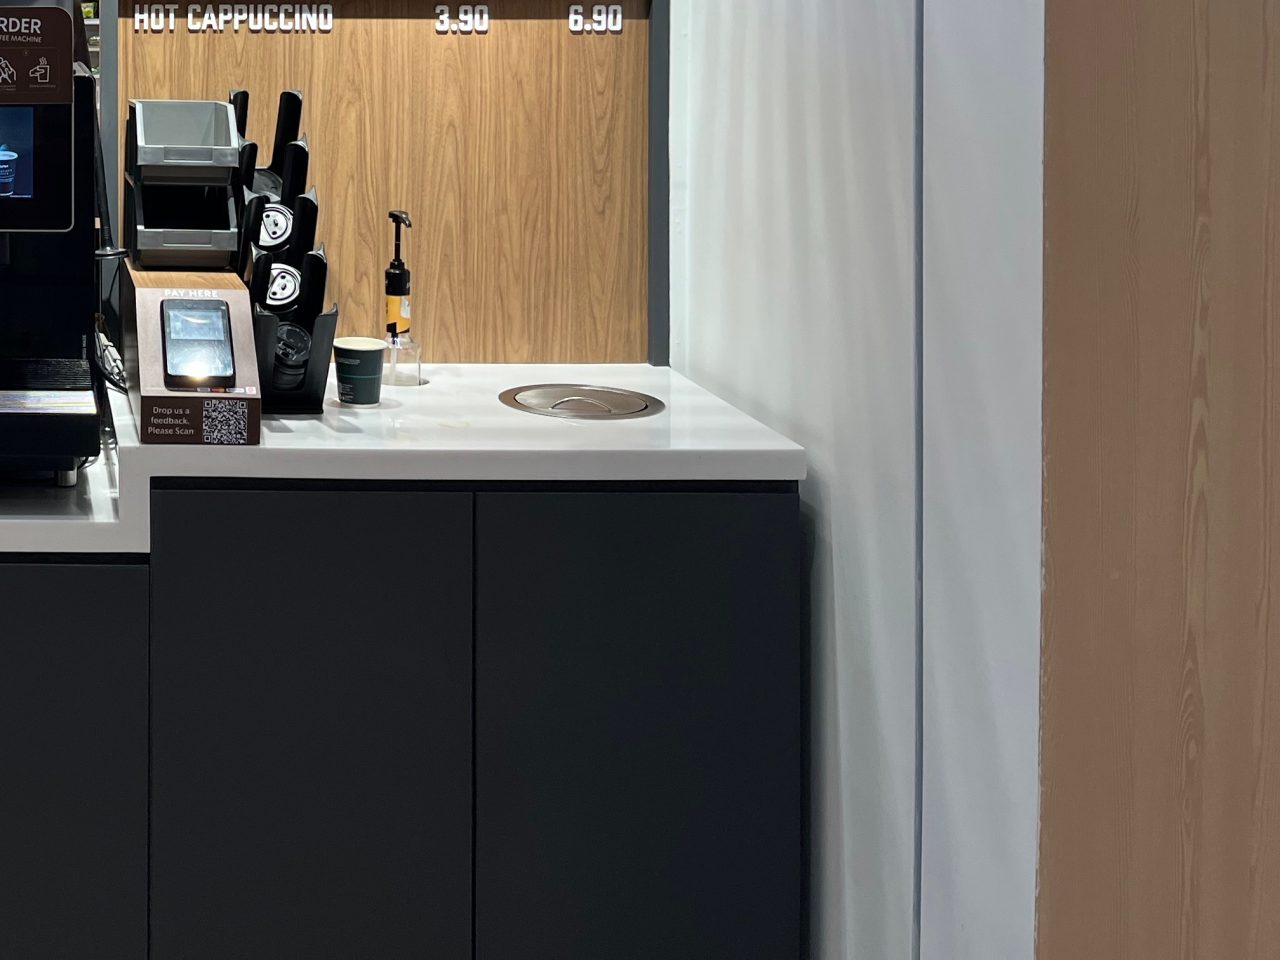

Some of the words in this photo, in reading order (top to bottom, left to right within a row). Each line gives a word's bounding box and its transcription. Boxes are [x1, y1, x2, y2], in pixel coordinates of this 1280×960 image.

[134, 4, 177, 33] HOT
[187, 4, 333, 33] CAPPUCCINO
[434, 4, 489, 33] 3.90
[568, 4, 622, 33] 6.90
[189, 290, 218, 298] HERE
[153, 407, 172, 416] Drop
[150, 416, 190, 424] feedback.
[148, 427, 173, 435] Please
[175, 427, 194, 435] Scan
